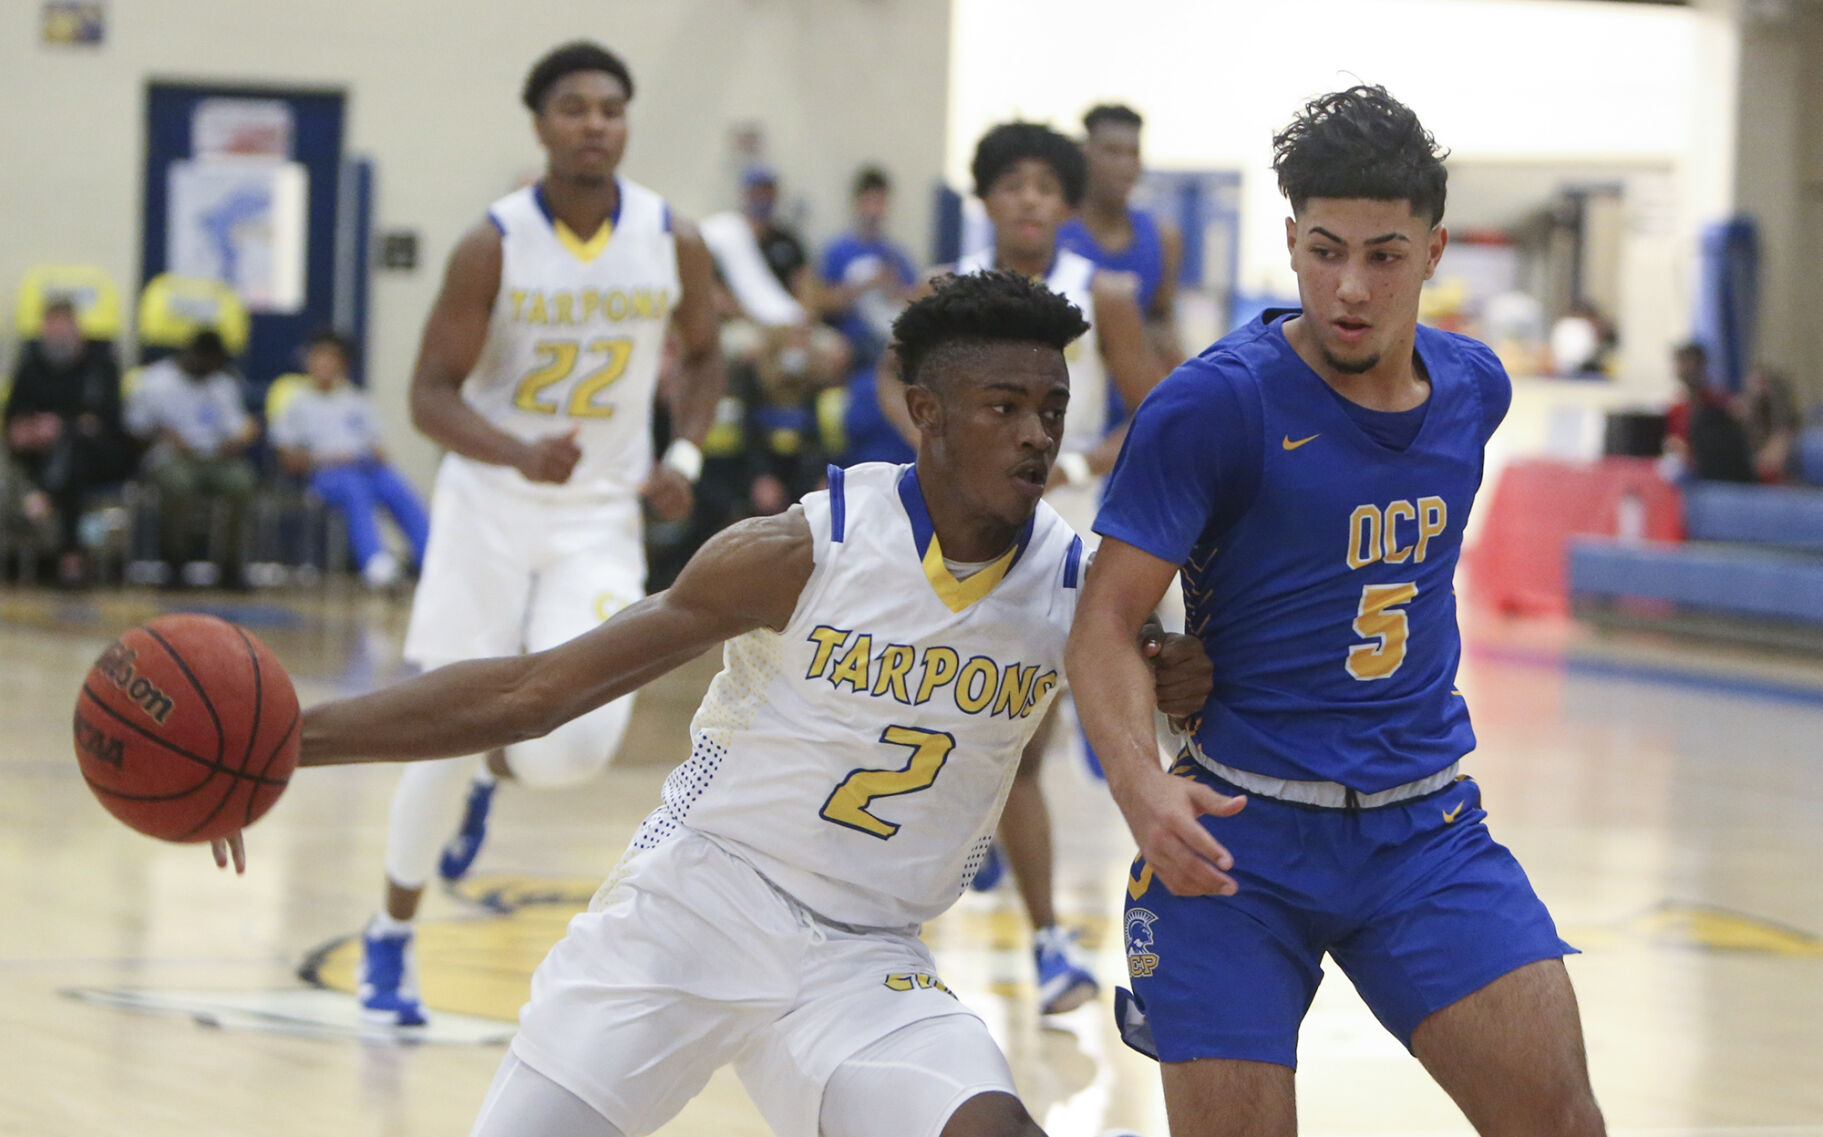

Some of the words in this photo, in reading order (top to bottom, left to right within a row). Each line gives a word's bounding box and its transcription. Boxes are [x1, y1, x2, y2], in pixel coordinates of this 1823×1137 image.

[513, 337, 634, 417] 22
[1346, 495, 1447, 570] OCP
[805, 625, 1058, 719] TARPONS
[1345, 581, 1419, 681] 5
[818, 724, 956, 841] 2
[1128, 954, 1160, 977] CP
